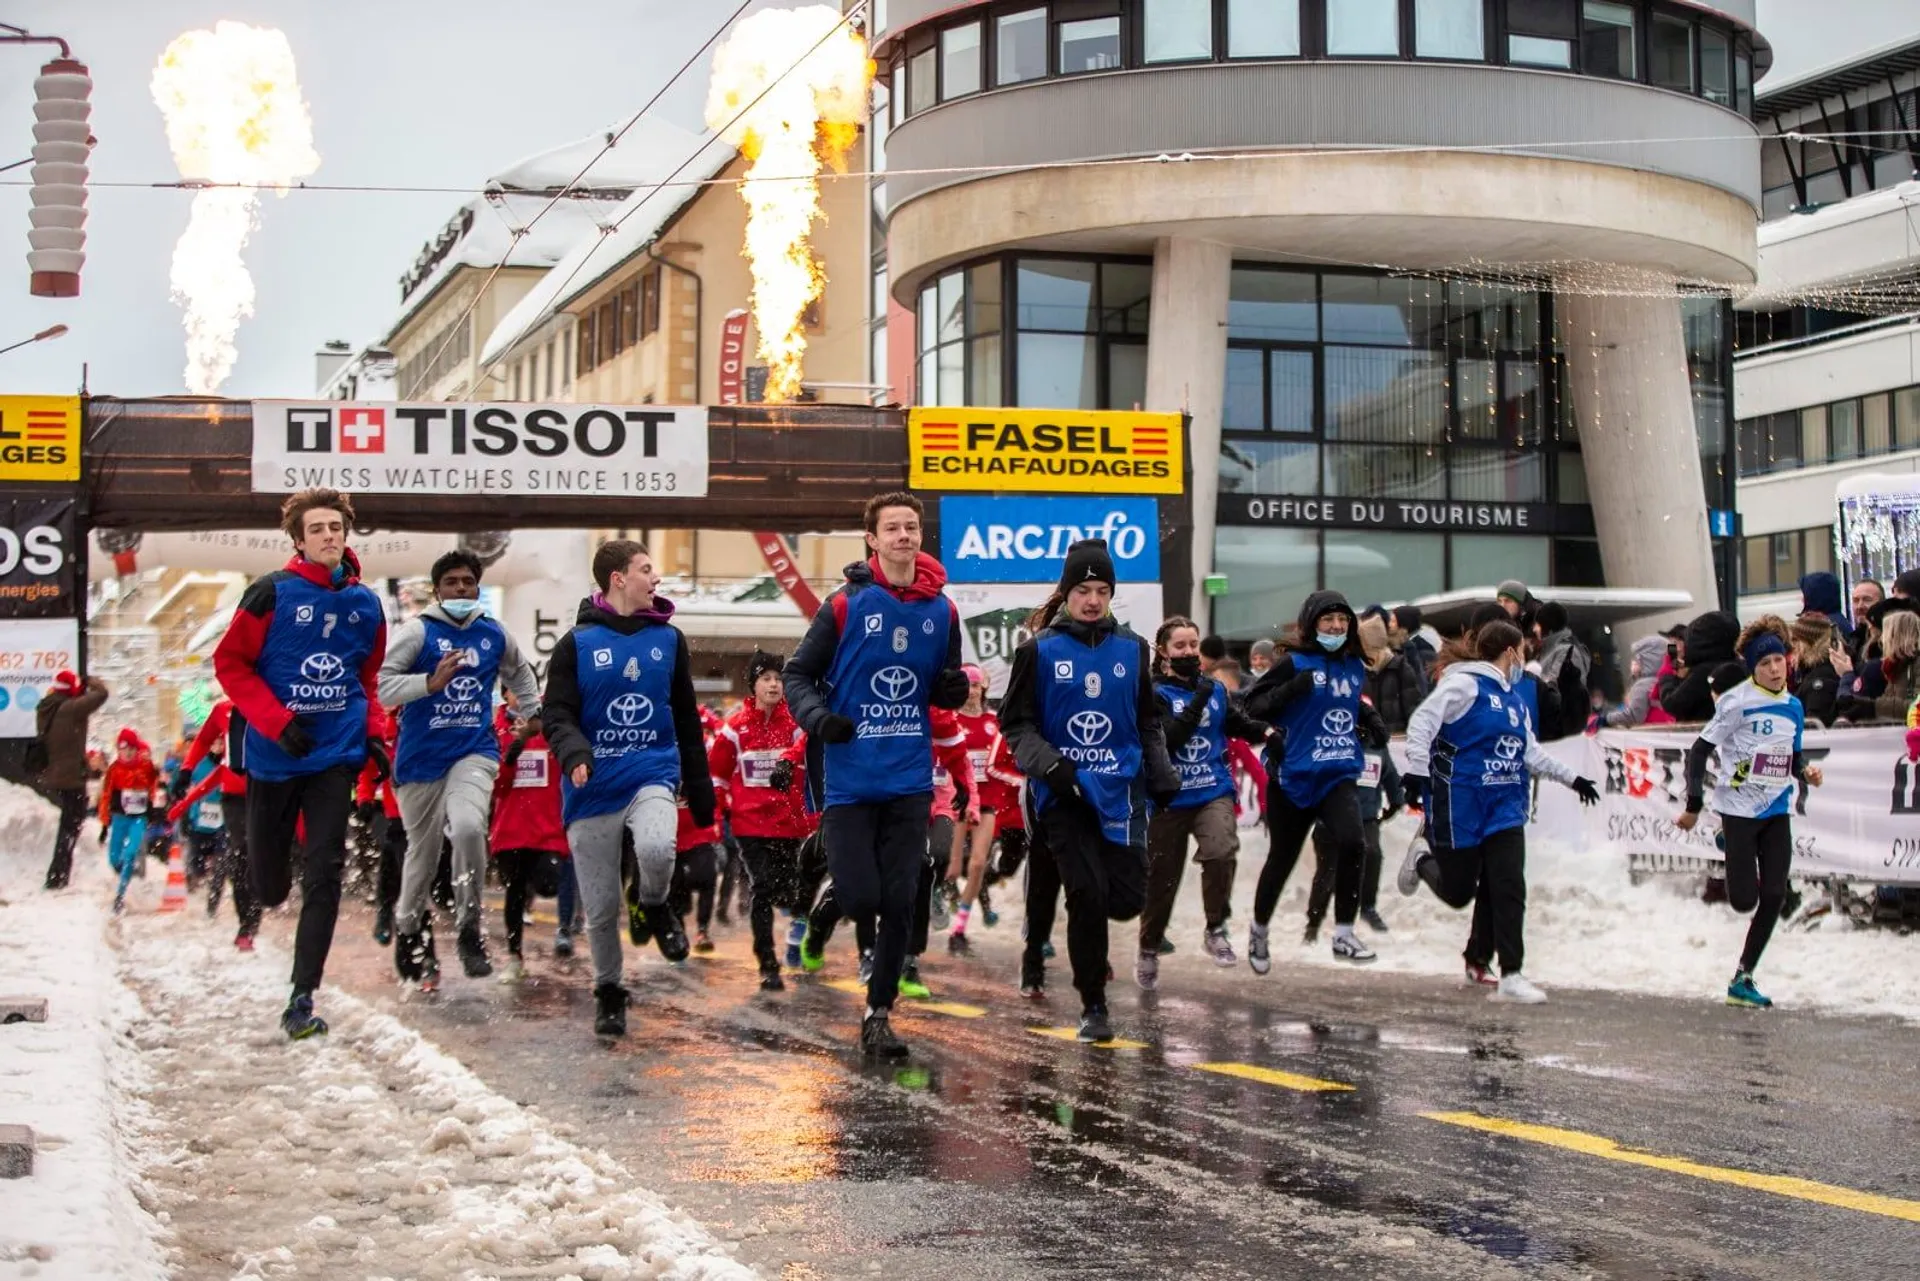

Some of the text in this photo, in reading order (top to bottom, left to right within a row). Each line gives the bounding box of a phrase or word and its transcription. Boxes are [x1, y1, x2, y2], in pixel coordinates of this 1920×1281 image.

[396, 409, 676, 457] TISSOT
[966, 423, 1127, 454] FASEL
[922, 456, 1170, 477] ECHAFAUDAGES
[284, 467, 677, 492] SWISS WATCHES SINCE 1853
[1248, 499, 1528, 526] OFFICE DU TOURISME
[763, 542, 799, 590] VUE
[322, 613, 338, 638] 7
[892, 626, 909, 653] 6
[32, 652, 70, 669] 762
[622, 656, 641, 682] 4
[290, 684, 347, 698] TOYOTA
[1084, 671, 1102, 698] 9
[1330, 678, 1352, 697] 14
[860, 704, 921, 718] TOYOTA
[596, 729, 658, 742] TOYOTA
[856, 719, 923, 739] Grandjean
[1751, 719, 1773, 735] 18
[1060, 747, 1117, 762] TOYOTA
